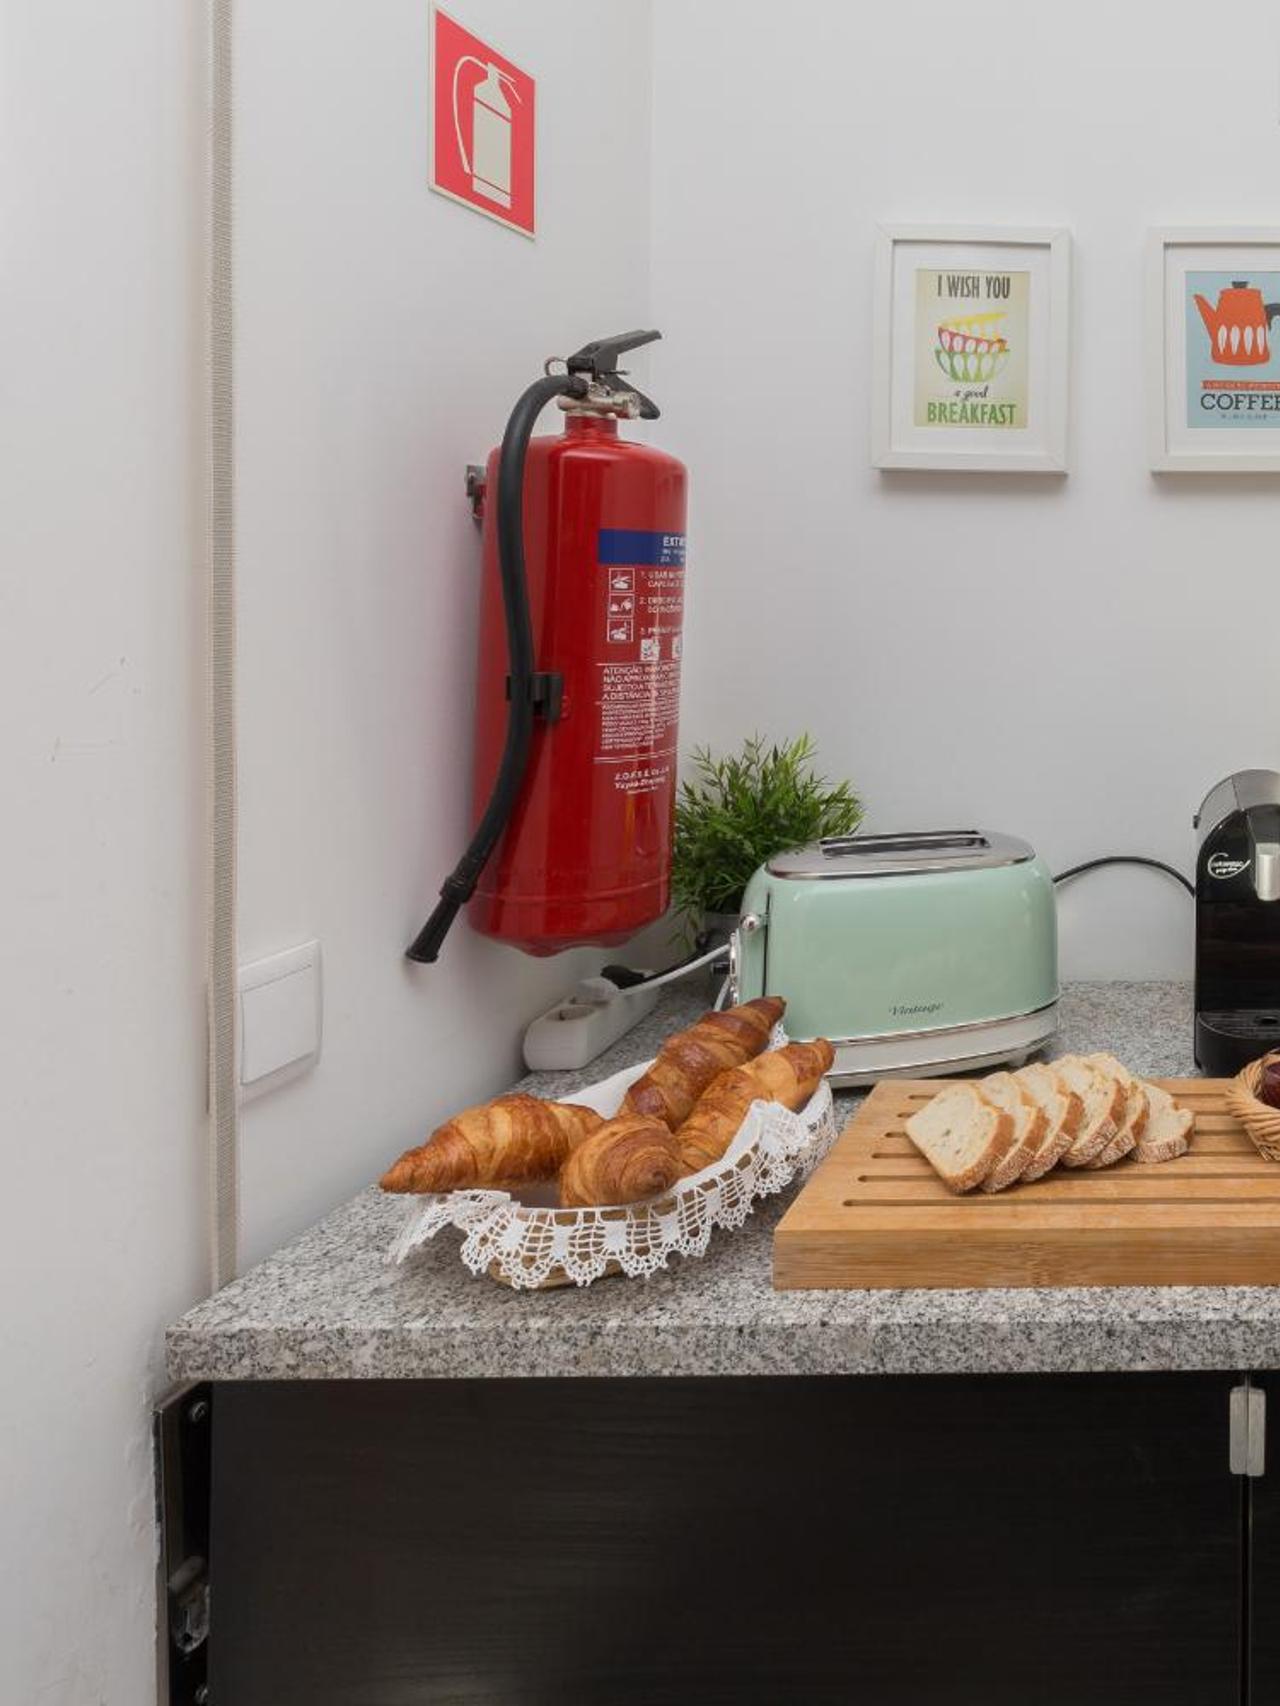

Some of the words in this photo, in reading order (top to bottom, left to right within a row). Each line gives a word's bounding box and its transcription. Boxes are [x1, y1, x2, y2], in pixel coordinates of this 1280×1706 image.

[937, 275, 943, 297] I
[947, 275, 980, 299] WISH
[985, 275, 1011, 299] YOU
[963, 385, 989, 400] good
[927, 402, 1017, 424] BREAKFAST
